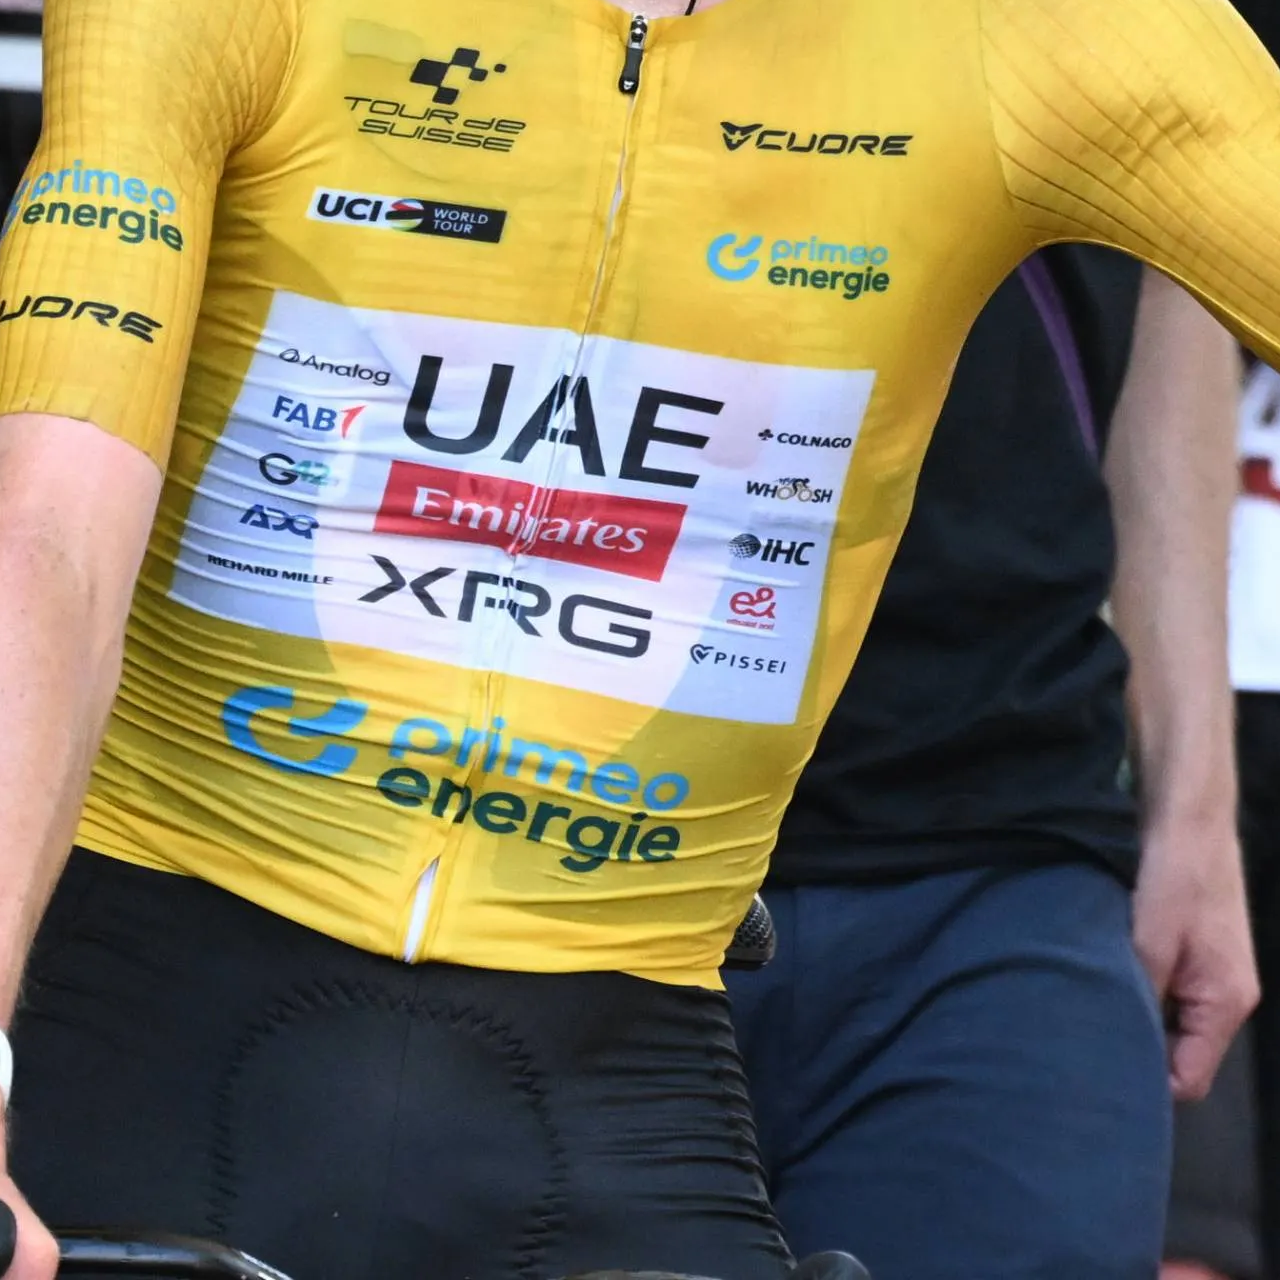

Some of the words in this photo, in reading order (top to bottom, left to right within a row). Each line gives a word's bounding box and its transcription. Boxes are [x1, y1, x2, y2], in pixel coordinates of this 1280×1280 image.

[344, 96, 459, 125] TOUR
[463, 118, 526, 135] de
[358, 118, 515, 152] SUISSE
[756, 130, 914, 156] CUORE
[30, 159, 177, 215] primeo
[317, 193, 383, 222] UCI
[433, 207, 489, 225] WORLD
[22, 202, 184, 252] energie
[433, 220, 474, 234] TOUR
[770, 235, 889, 267] primeo
[767, 265, 890, 300] energie
[302, 354, 391, 386] Analog
[403, 353, 725, 489] UAE
[777, 432, 852, 449] COLNAGO
[258, 452, 332, 487] G42
[411, 486, 648, 554] Emirates
[761, 539, 815, 566] IHC
[207, 554, 278, 579] RICHARD
[281, 570, 333, 586] MILLE
[357, 554, 653, 658] XRG
[714, 652, 787, 674] PISSEI
[389, 716, 690, 811] primeo
[376, 766, 680, 872] energie
